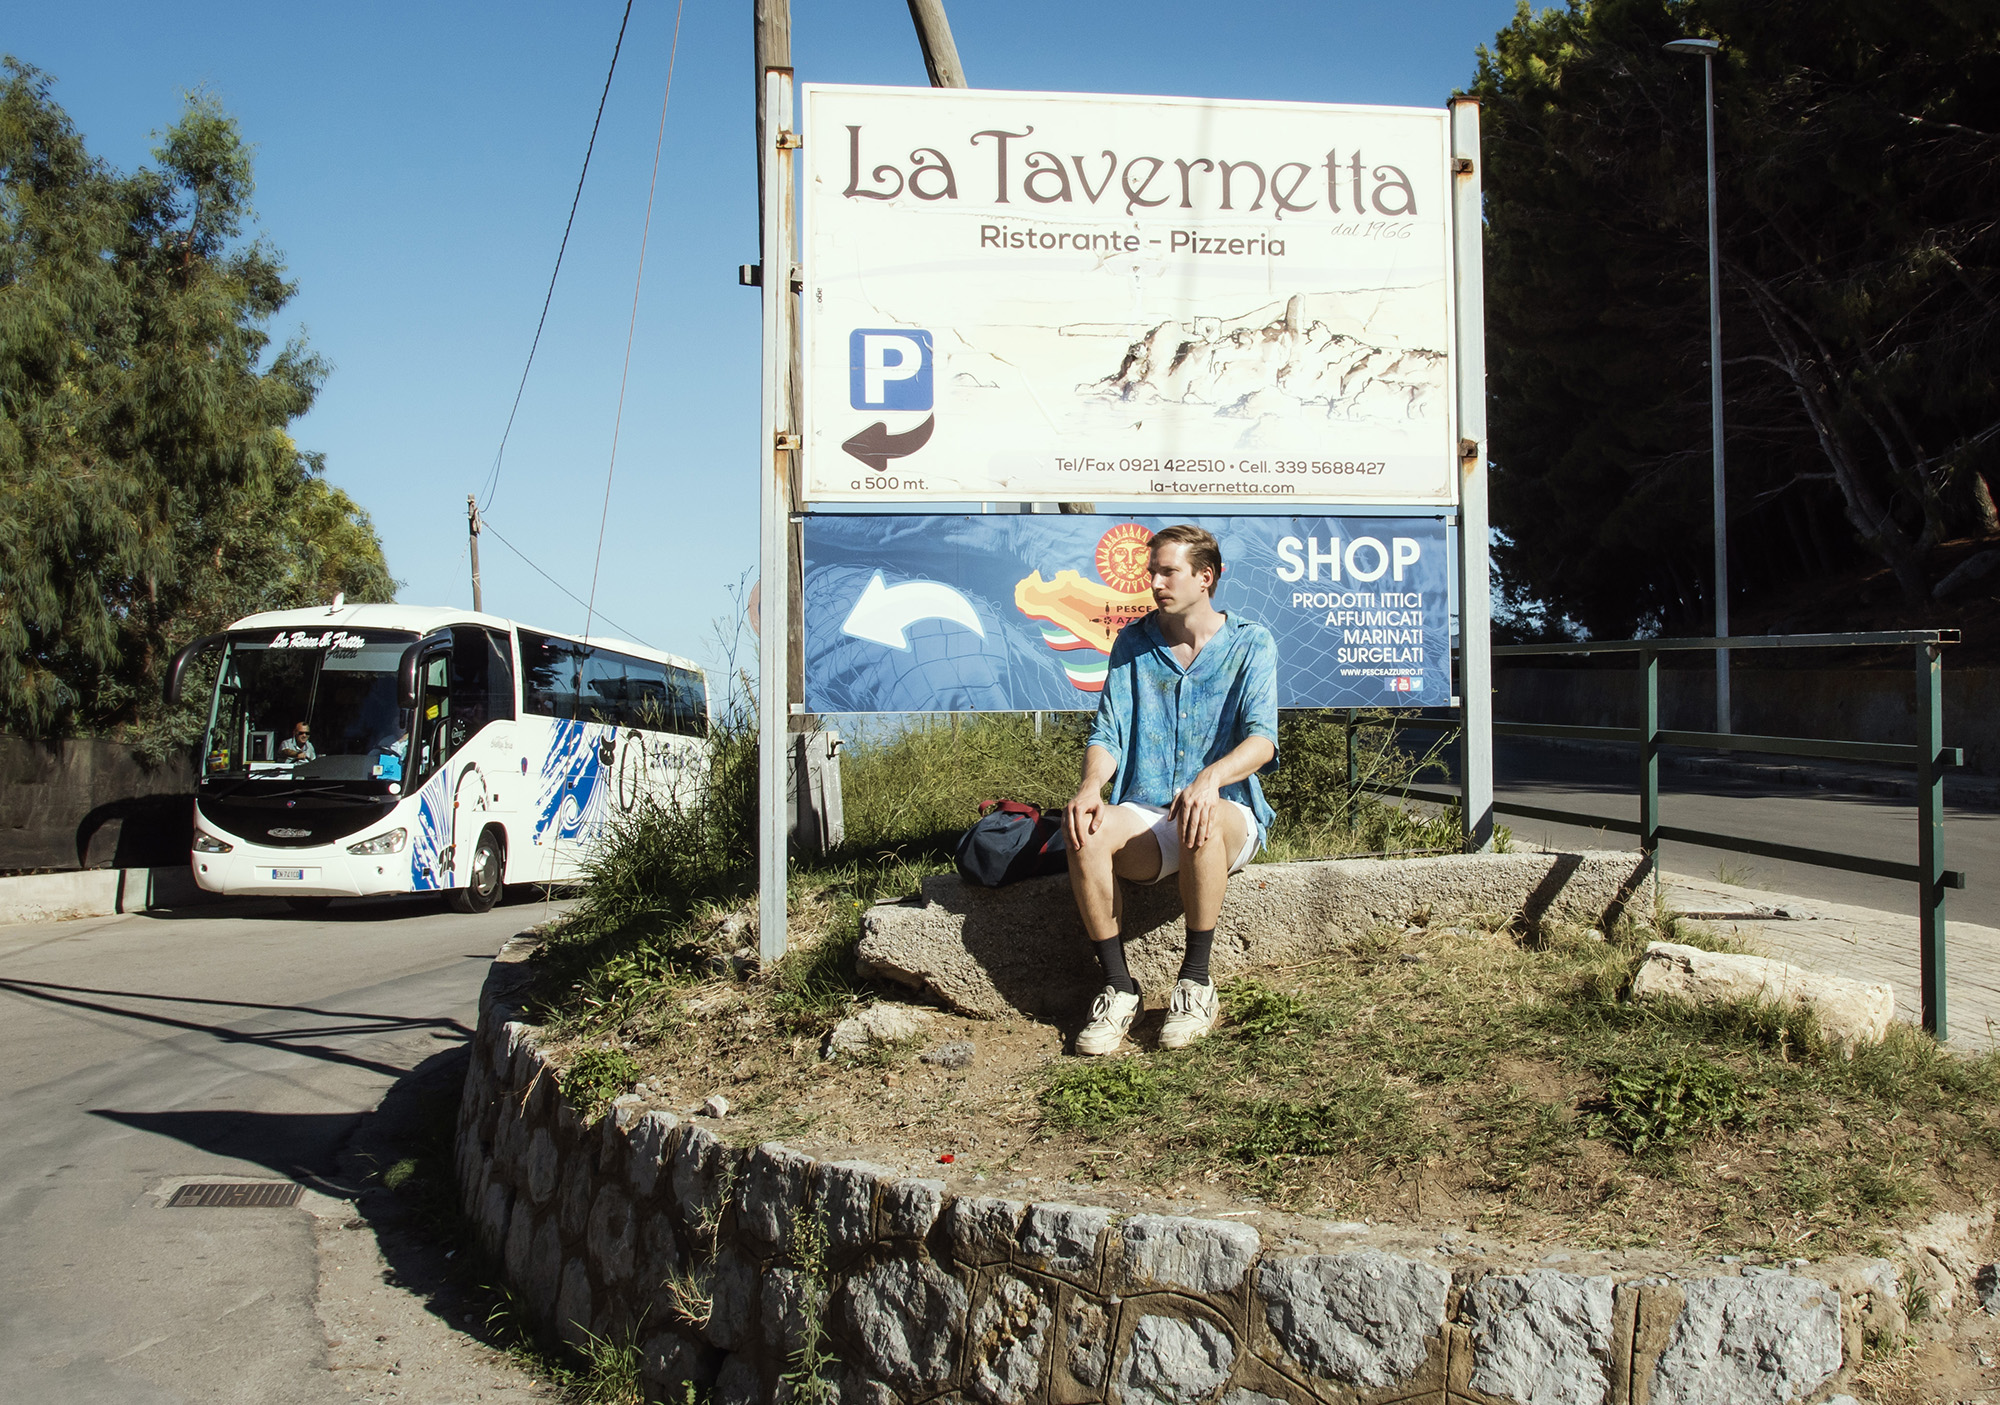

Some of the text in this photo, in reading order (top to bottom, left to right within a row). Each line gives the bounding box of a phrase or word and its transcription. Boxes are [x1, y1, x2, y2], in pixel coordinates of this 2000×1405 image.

[842, 125, 1418, 220] La Tavernetta
[1331, 221, 1414, 240] dal 1966
[980, 224, 1141, 252] Ristorante
[1170, 230, 1286, 257] Pizzeria
[864, 335, 922, 403] P
[1055, 457, 1386, 475] Tel/Fax 0921 422510 Cell. 339 5688427
[850, 477, 929, 490] a 500 mt.
[1150, 480, 1295, 493] la-tavernetta.com
[1276, 536, 1421, 582] SHOP
[1292, 592, 1422, 608] PRODOTTI ITTICI
[1116, 605, 1152, 613] PESCE
[1325, 611, 1423, 626] AFFUMICATI
[1343, 629, 1423, 645] MARINATI
[1337, 647, 1424, 663] SURGELATI
[1339, 668, 1424, 676] WWW.PESCEAZZURRO.IT
